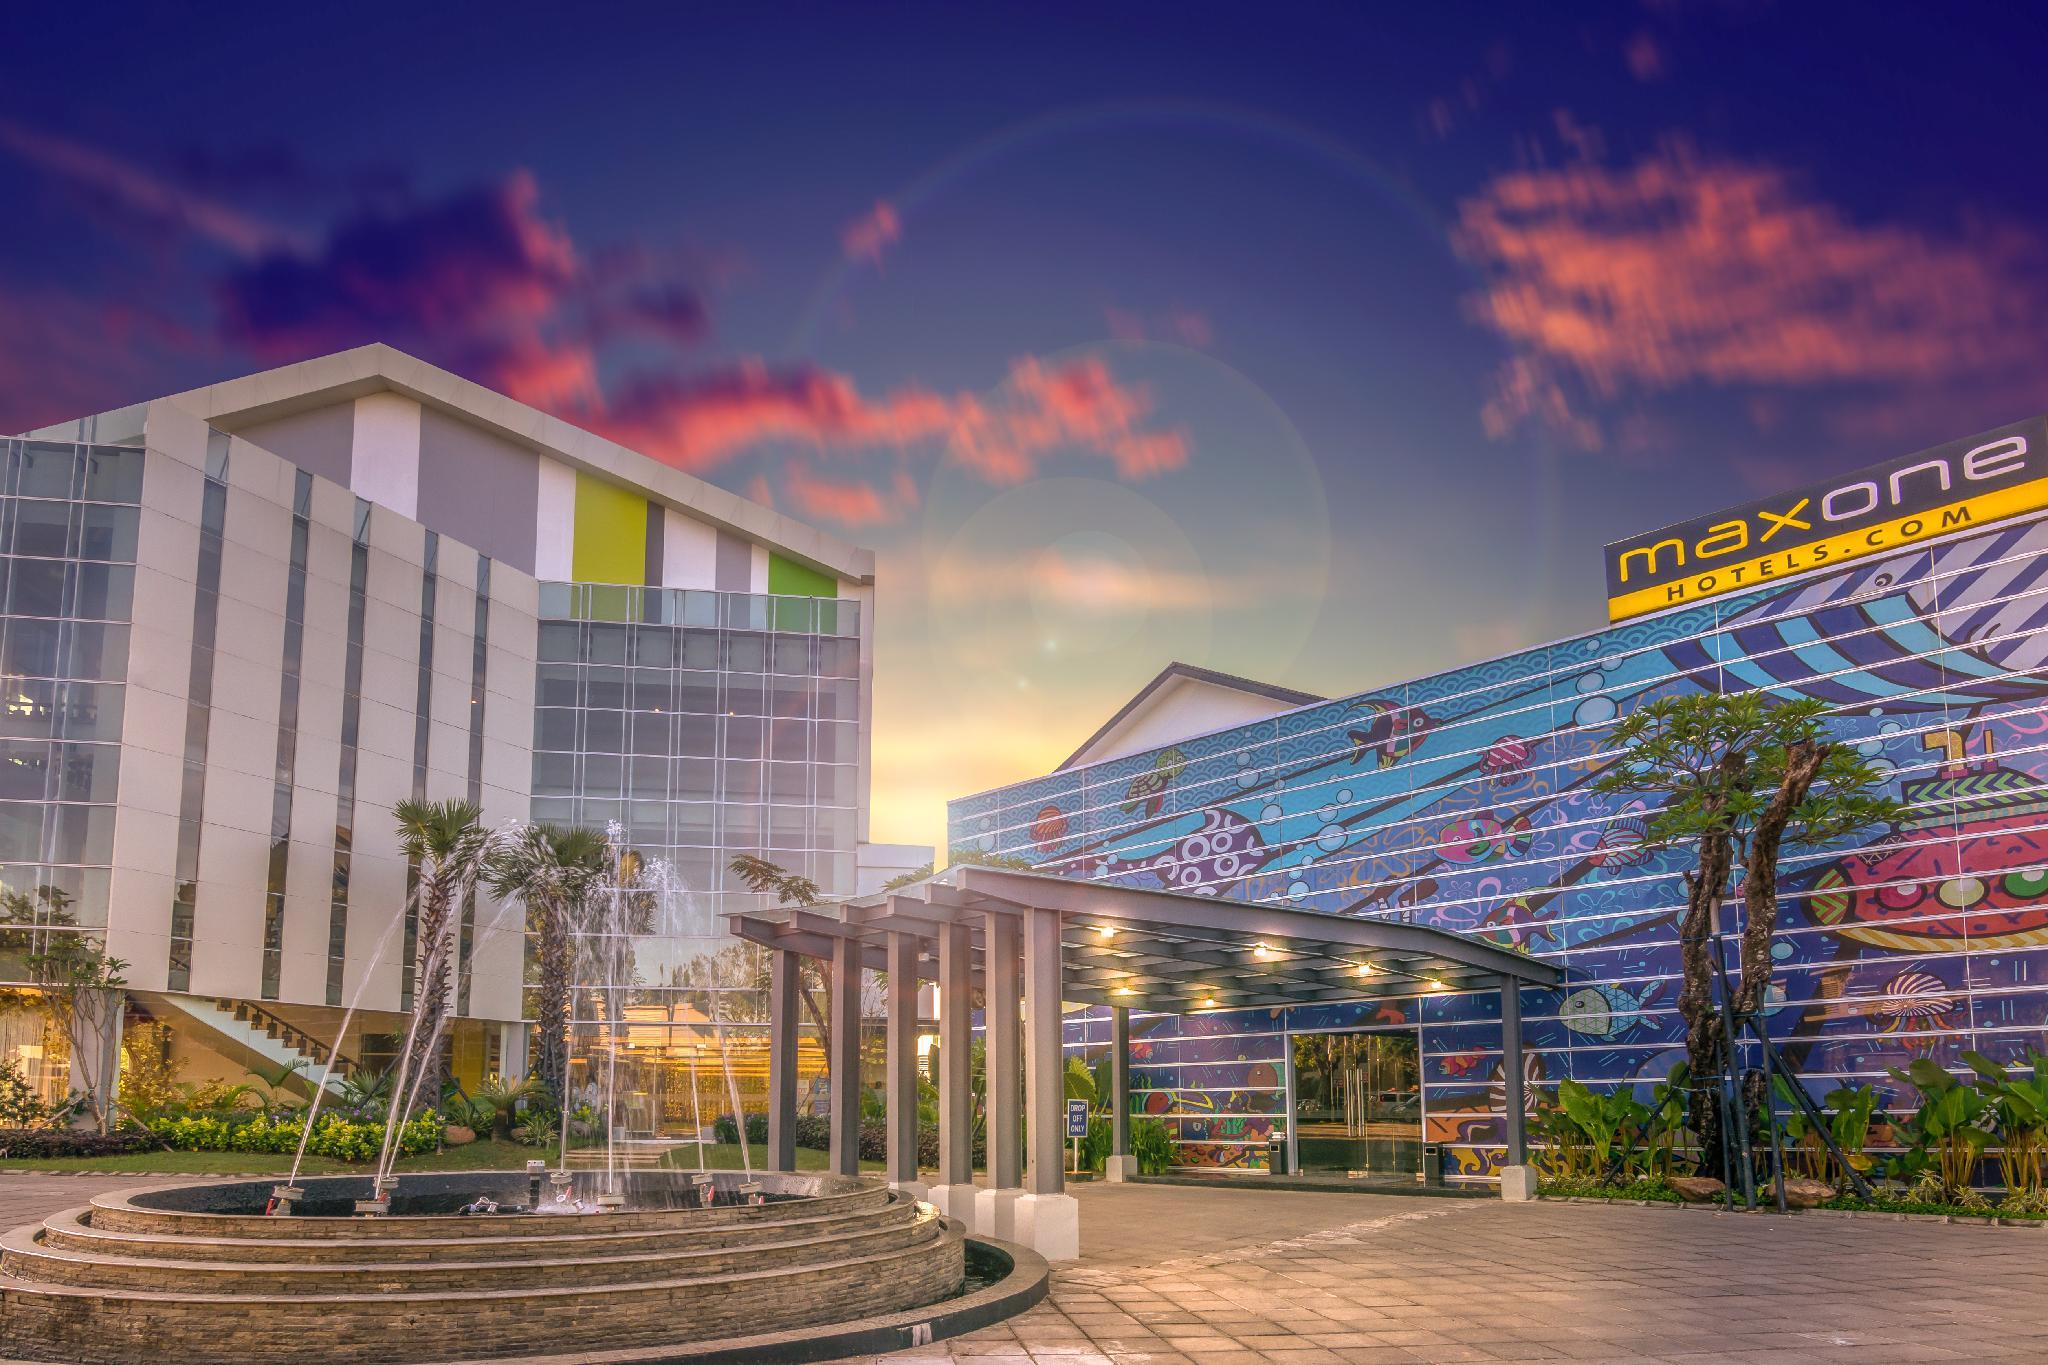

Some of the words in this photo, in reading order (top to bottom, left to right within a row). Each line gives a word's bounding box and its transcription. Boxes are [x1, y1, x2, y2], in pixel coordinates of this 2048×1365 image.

[1618, 436, 2027, 583] maxone
[1667, 506, 1972, 601] HOTELS.COM
[1070, 1104, 1086, 1112] DROP
[1072, 1114, 1083, 1122] OFF
[1070, 1125, 1084, 1133] ONLY
